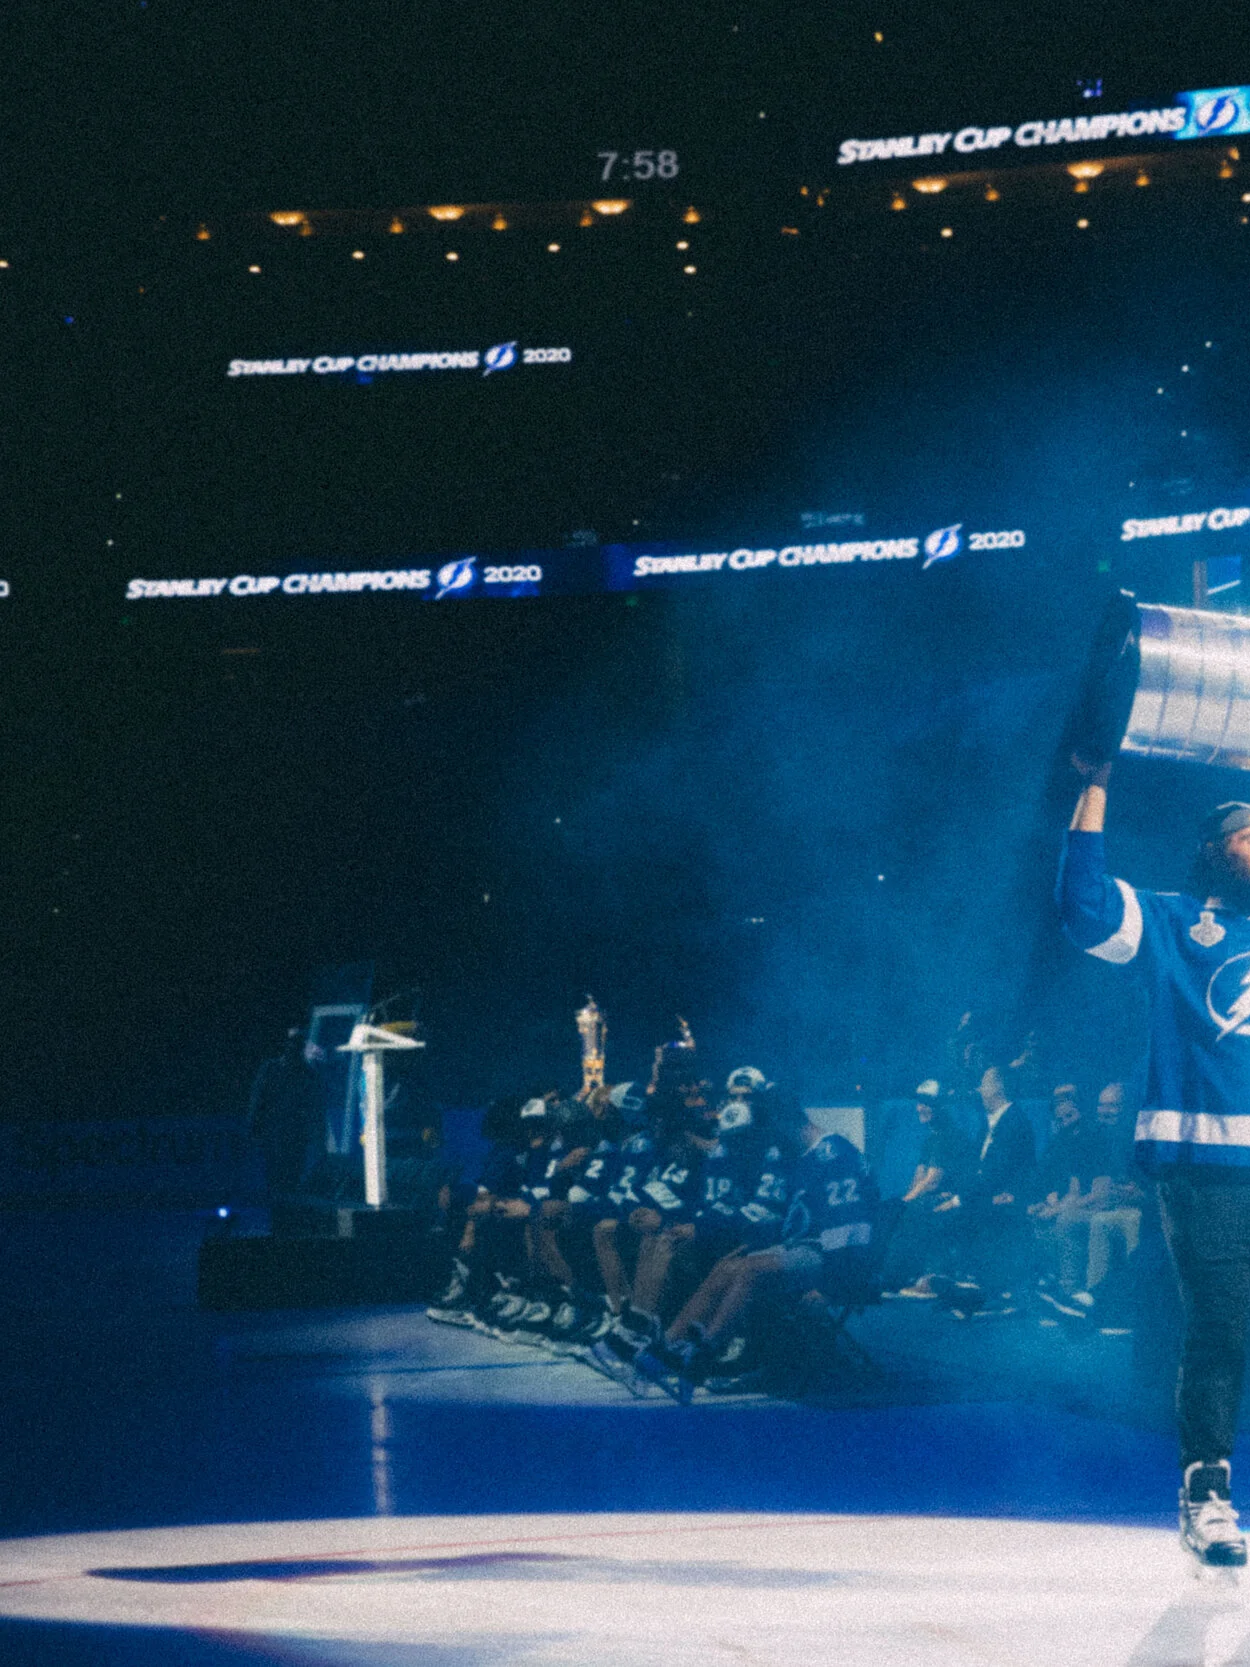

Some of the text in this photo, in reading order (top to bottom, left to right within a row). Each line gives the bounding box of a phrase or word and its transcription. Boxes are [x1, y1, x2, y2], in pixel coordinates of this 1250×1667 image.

[837, 131, 953, 165] STANLEY
[953, 126, 1013, 153] CUP
[1014, 107, 1187, 147] CHAMPIONS
[597, 148, 680, 181] 7:58
[227, 347, 572, 377] STANLEY CUP CHAMPIONS 2020
[1120, 513, 1207, 541] STANLEY
[633, 529, 1026, 577] STANLEY CUP CHAMPIONS 2020
[126, 565, 542, 599] STANLEY CUP CHAMPIONS 2020
[826, 1178, 860, 1207] 22
